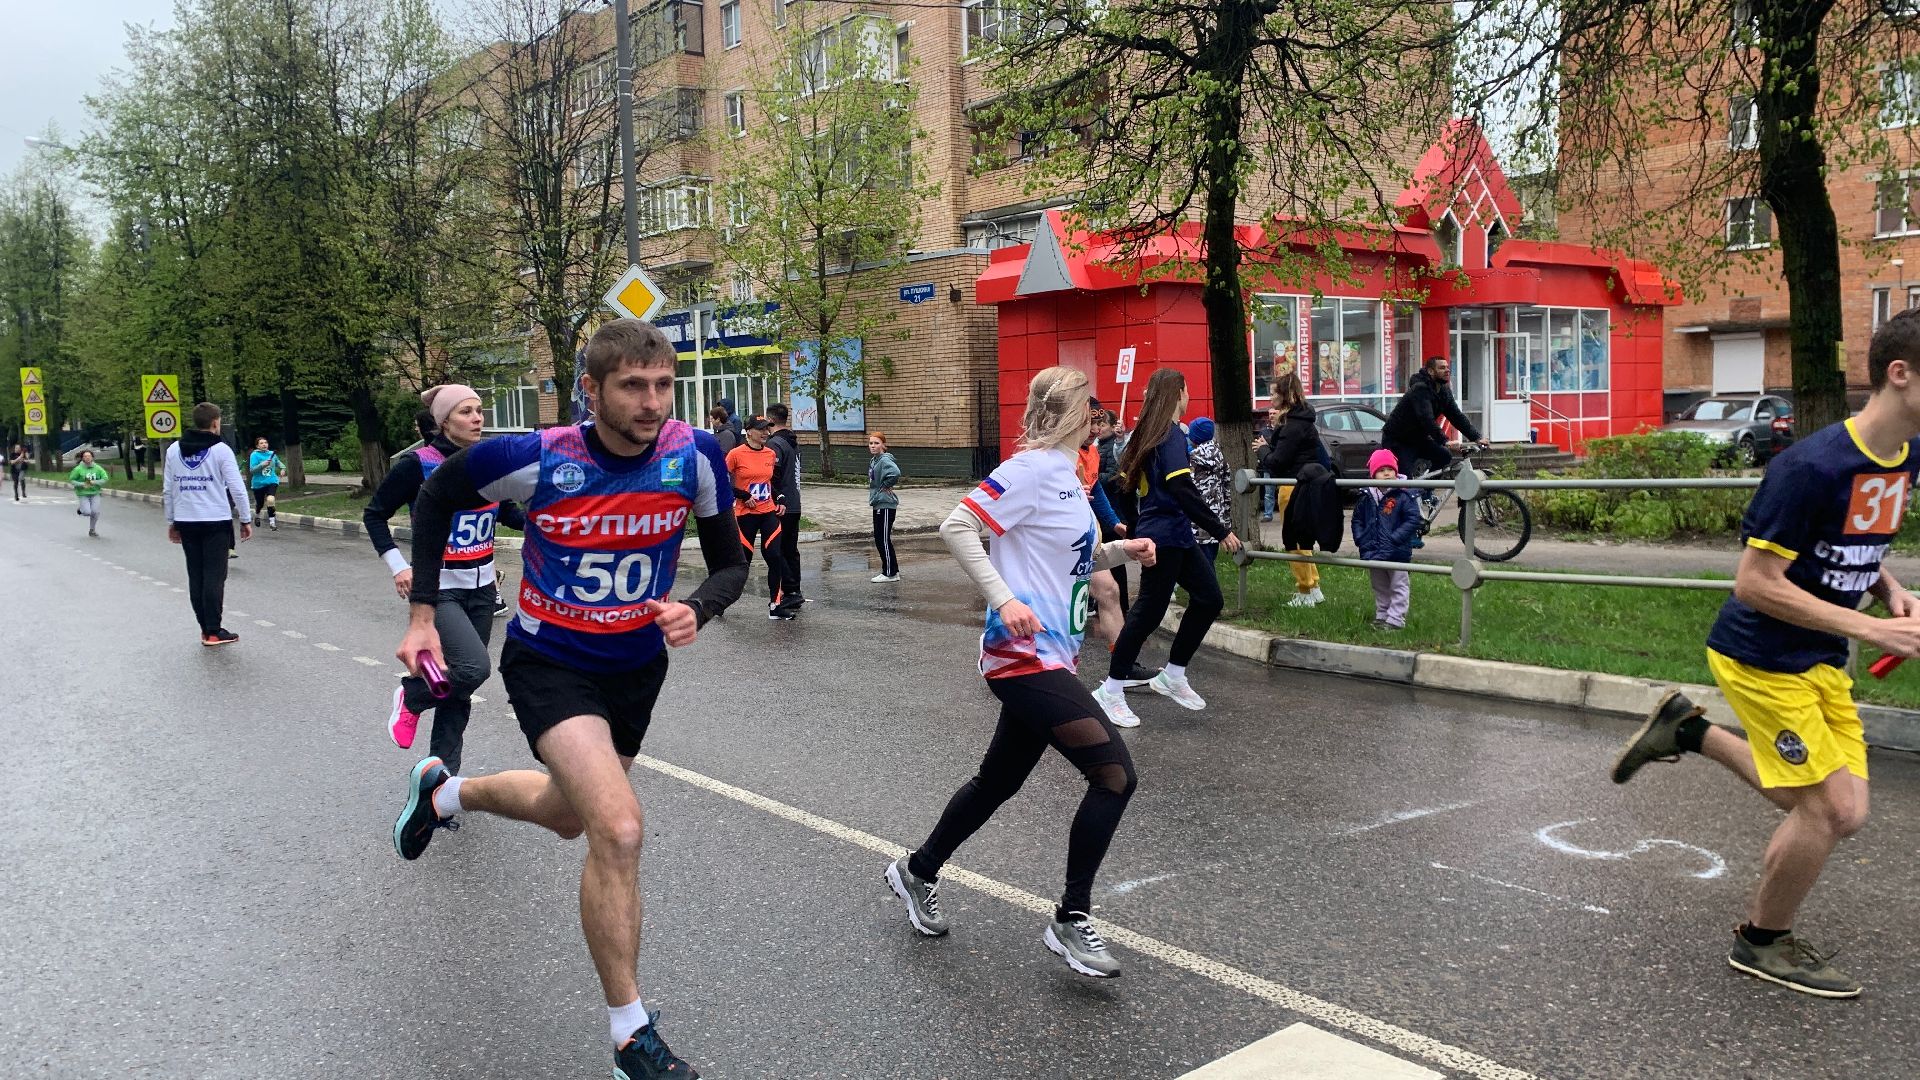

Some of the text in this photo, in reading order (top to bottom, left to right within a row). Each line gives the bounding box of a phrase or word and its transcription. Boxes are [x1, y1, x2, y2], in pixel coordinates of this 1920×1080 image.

[913, 294, 921, 302] 21
[1121, 354, 1131, 375] 5
[1300, 317, 1310, 392] ПЕЛЬМЕНИ
[1385, 319, 1393, 391] ПЕЛЬМЕНИ
[156, 417, 172, 427] 40
[750, 483, 770, 500] 44
[1852, 475, 1906, 531] 31
[455, 512, 493, 546] 50
[535, 506, 688, 536] СТУПИНО
[571, 552, 652, 603] 50
